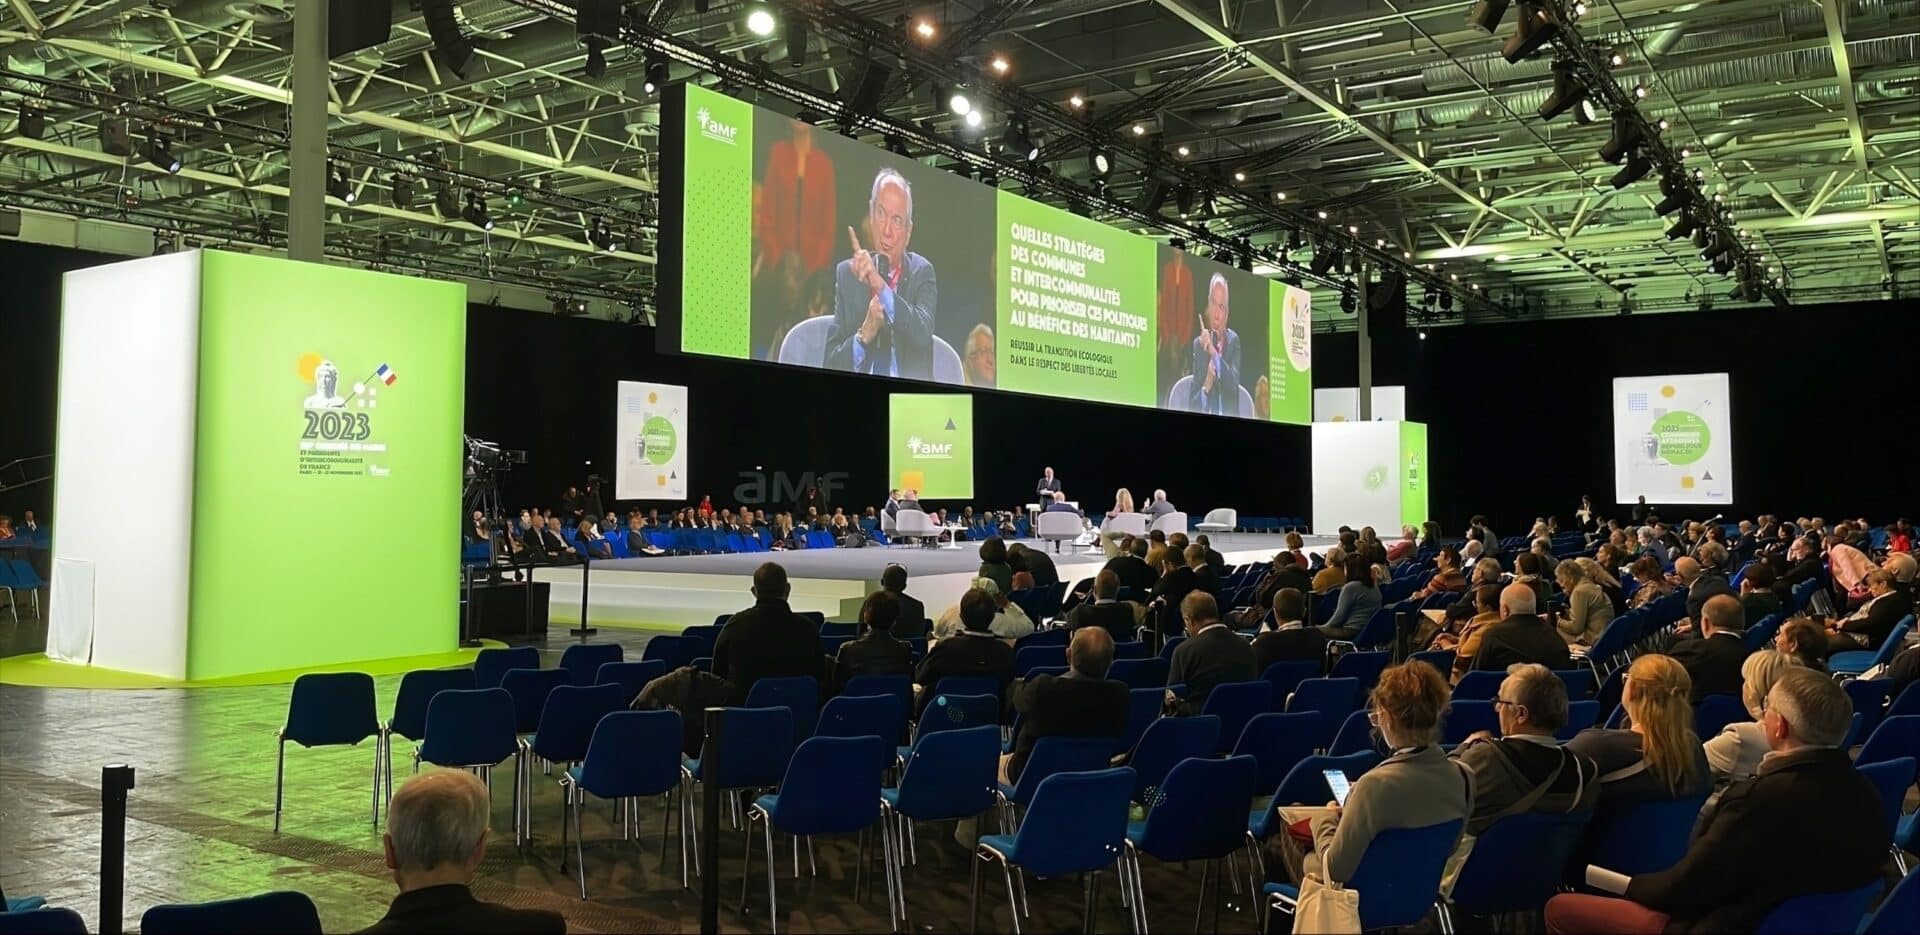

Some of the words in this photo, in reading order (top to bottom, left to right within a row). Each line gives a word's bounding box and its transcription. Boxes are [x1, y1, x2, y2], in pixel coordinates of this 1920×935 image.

[1011, 222, 1052, 249] QUELLES
[1053, 234, 1105, 263] STRATÉGIES
[1010, 244, 1029, 263] DES
[1031, 250, 1086, 278] COMMUNES
[1010, 266, 1022, 283] ET
[1023, 268, 1121, 306] INTERCOMMUNALITÉS
[1010, 287, 1039, 308] POUR
[1040, 293, 1086, 318] PRIORISER
[1087, 305, 1102, 321] CES
[1103, 308, 1148, 332] POLITIQUES
[1010, 309, 1026, 327] AU
[1027, 311, 1072, 335] BÉNÉFICE
[1072, 321, 1089, 338] DES
[1090, 325, 1135, 348] HABITANTS
[1010, 354, 1027, 366] DANS
[1028, 356, 1035, 367] LE
[1035, 358, 1060, 371] RESPECT
[1060, 361, 1071, 372] DES
[1095, 366, 1118, 379] LOCALES
[1035, 343, 1043, 353] LA
[1044, 344, 1078, 360] TRANSITION
[302, 410, 371, 441] 2023
